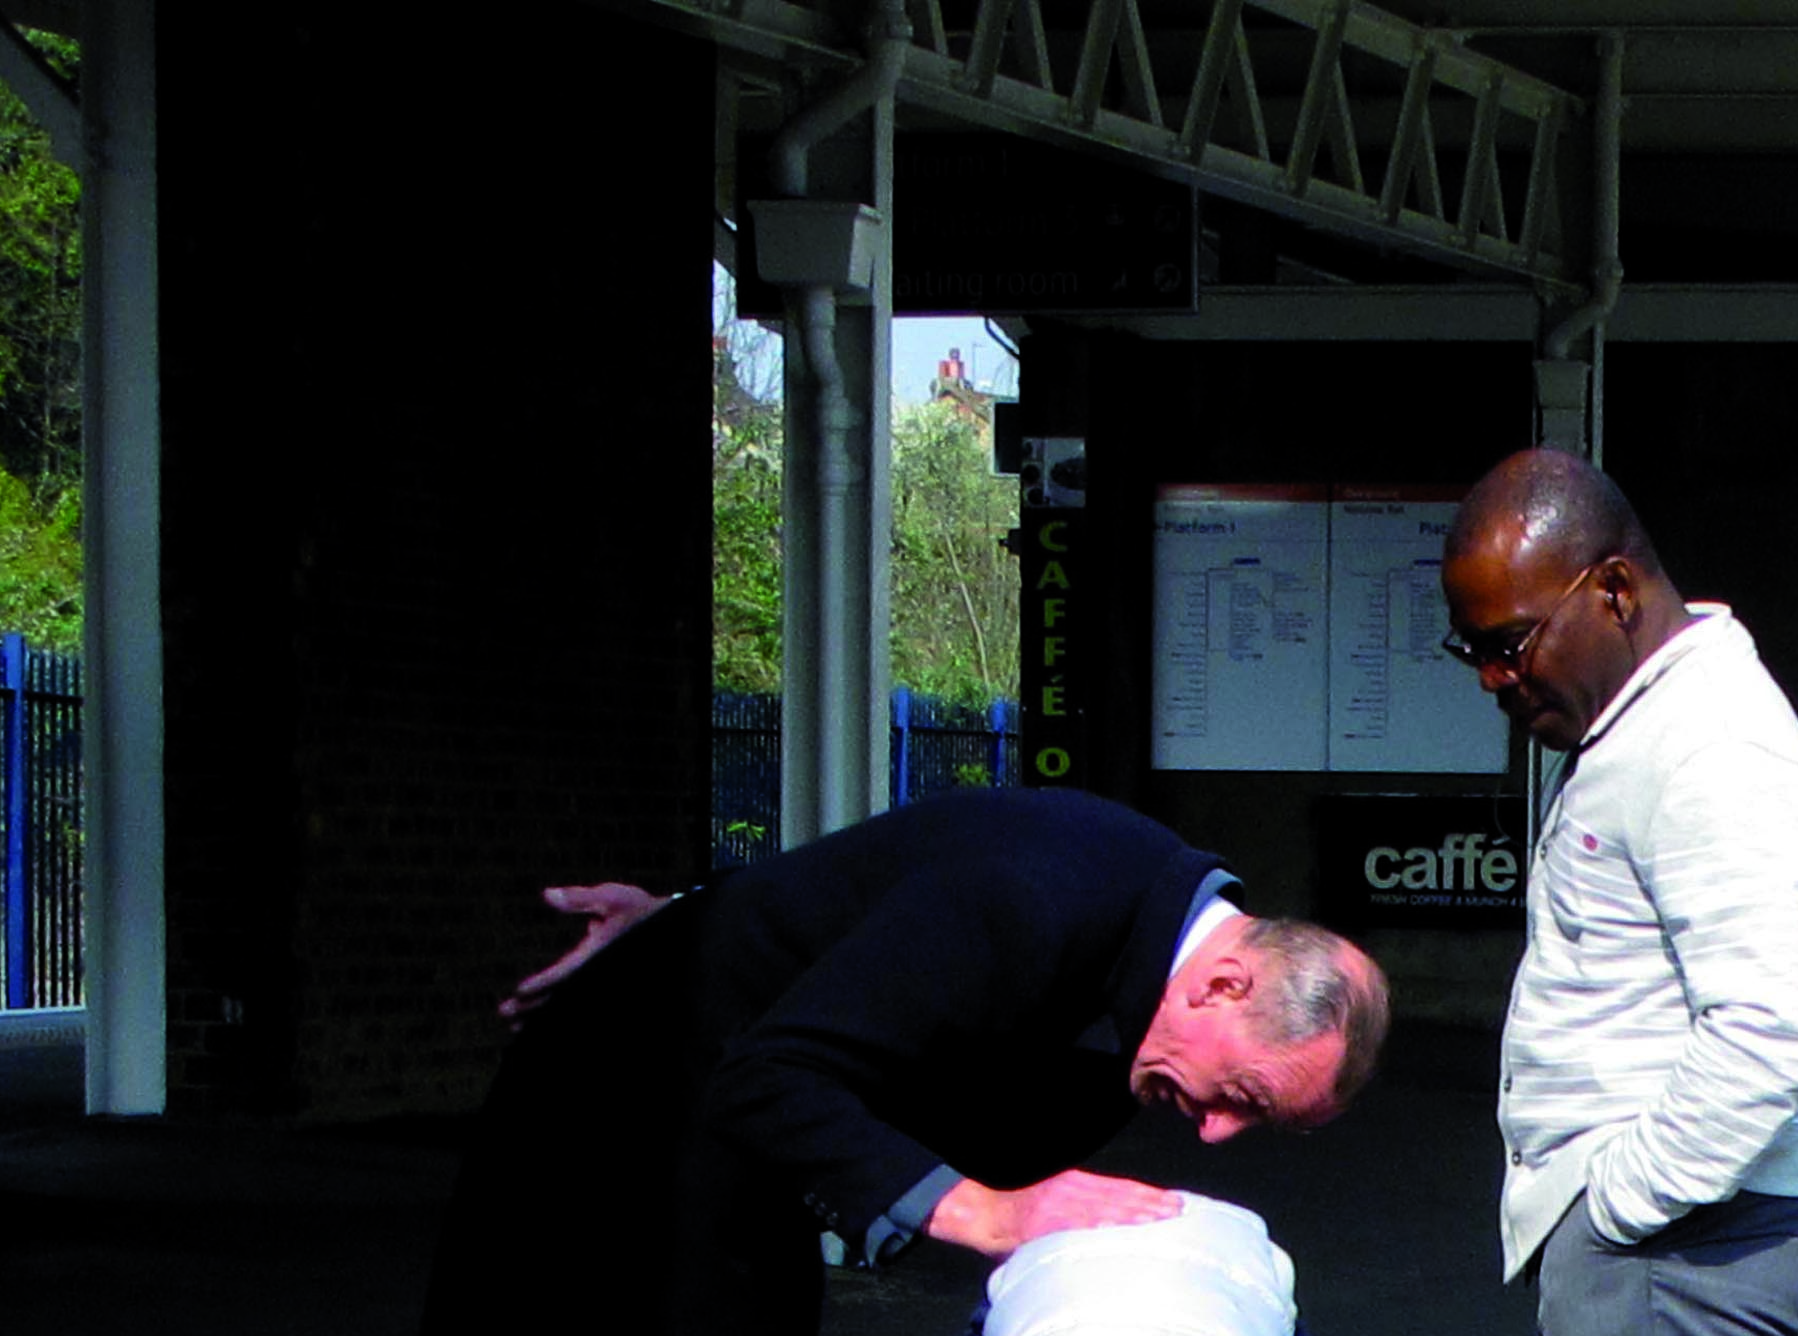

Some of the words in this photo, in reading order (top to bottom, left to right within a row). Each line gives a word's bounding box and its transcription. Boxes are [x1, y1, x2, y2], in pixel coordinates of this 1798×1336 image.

[895, 147, 986, 178] tform
[895, 267, 985, 306] aiting
[994, 271, 1079, 297] room
[1035, 520, 1071, 717] CAFFÉ
[1364, 833, 1519, 893] caffé
